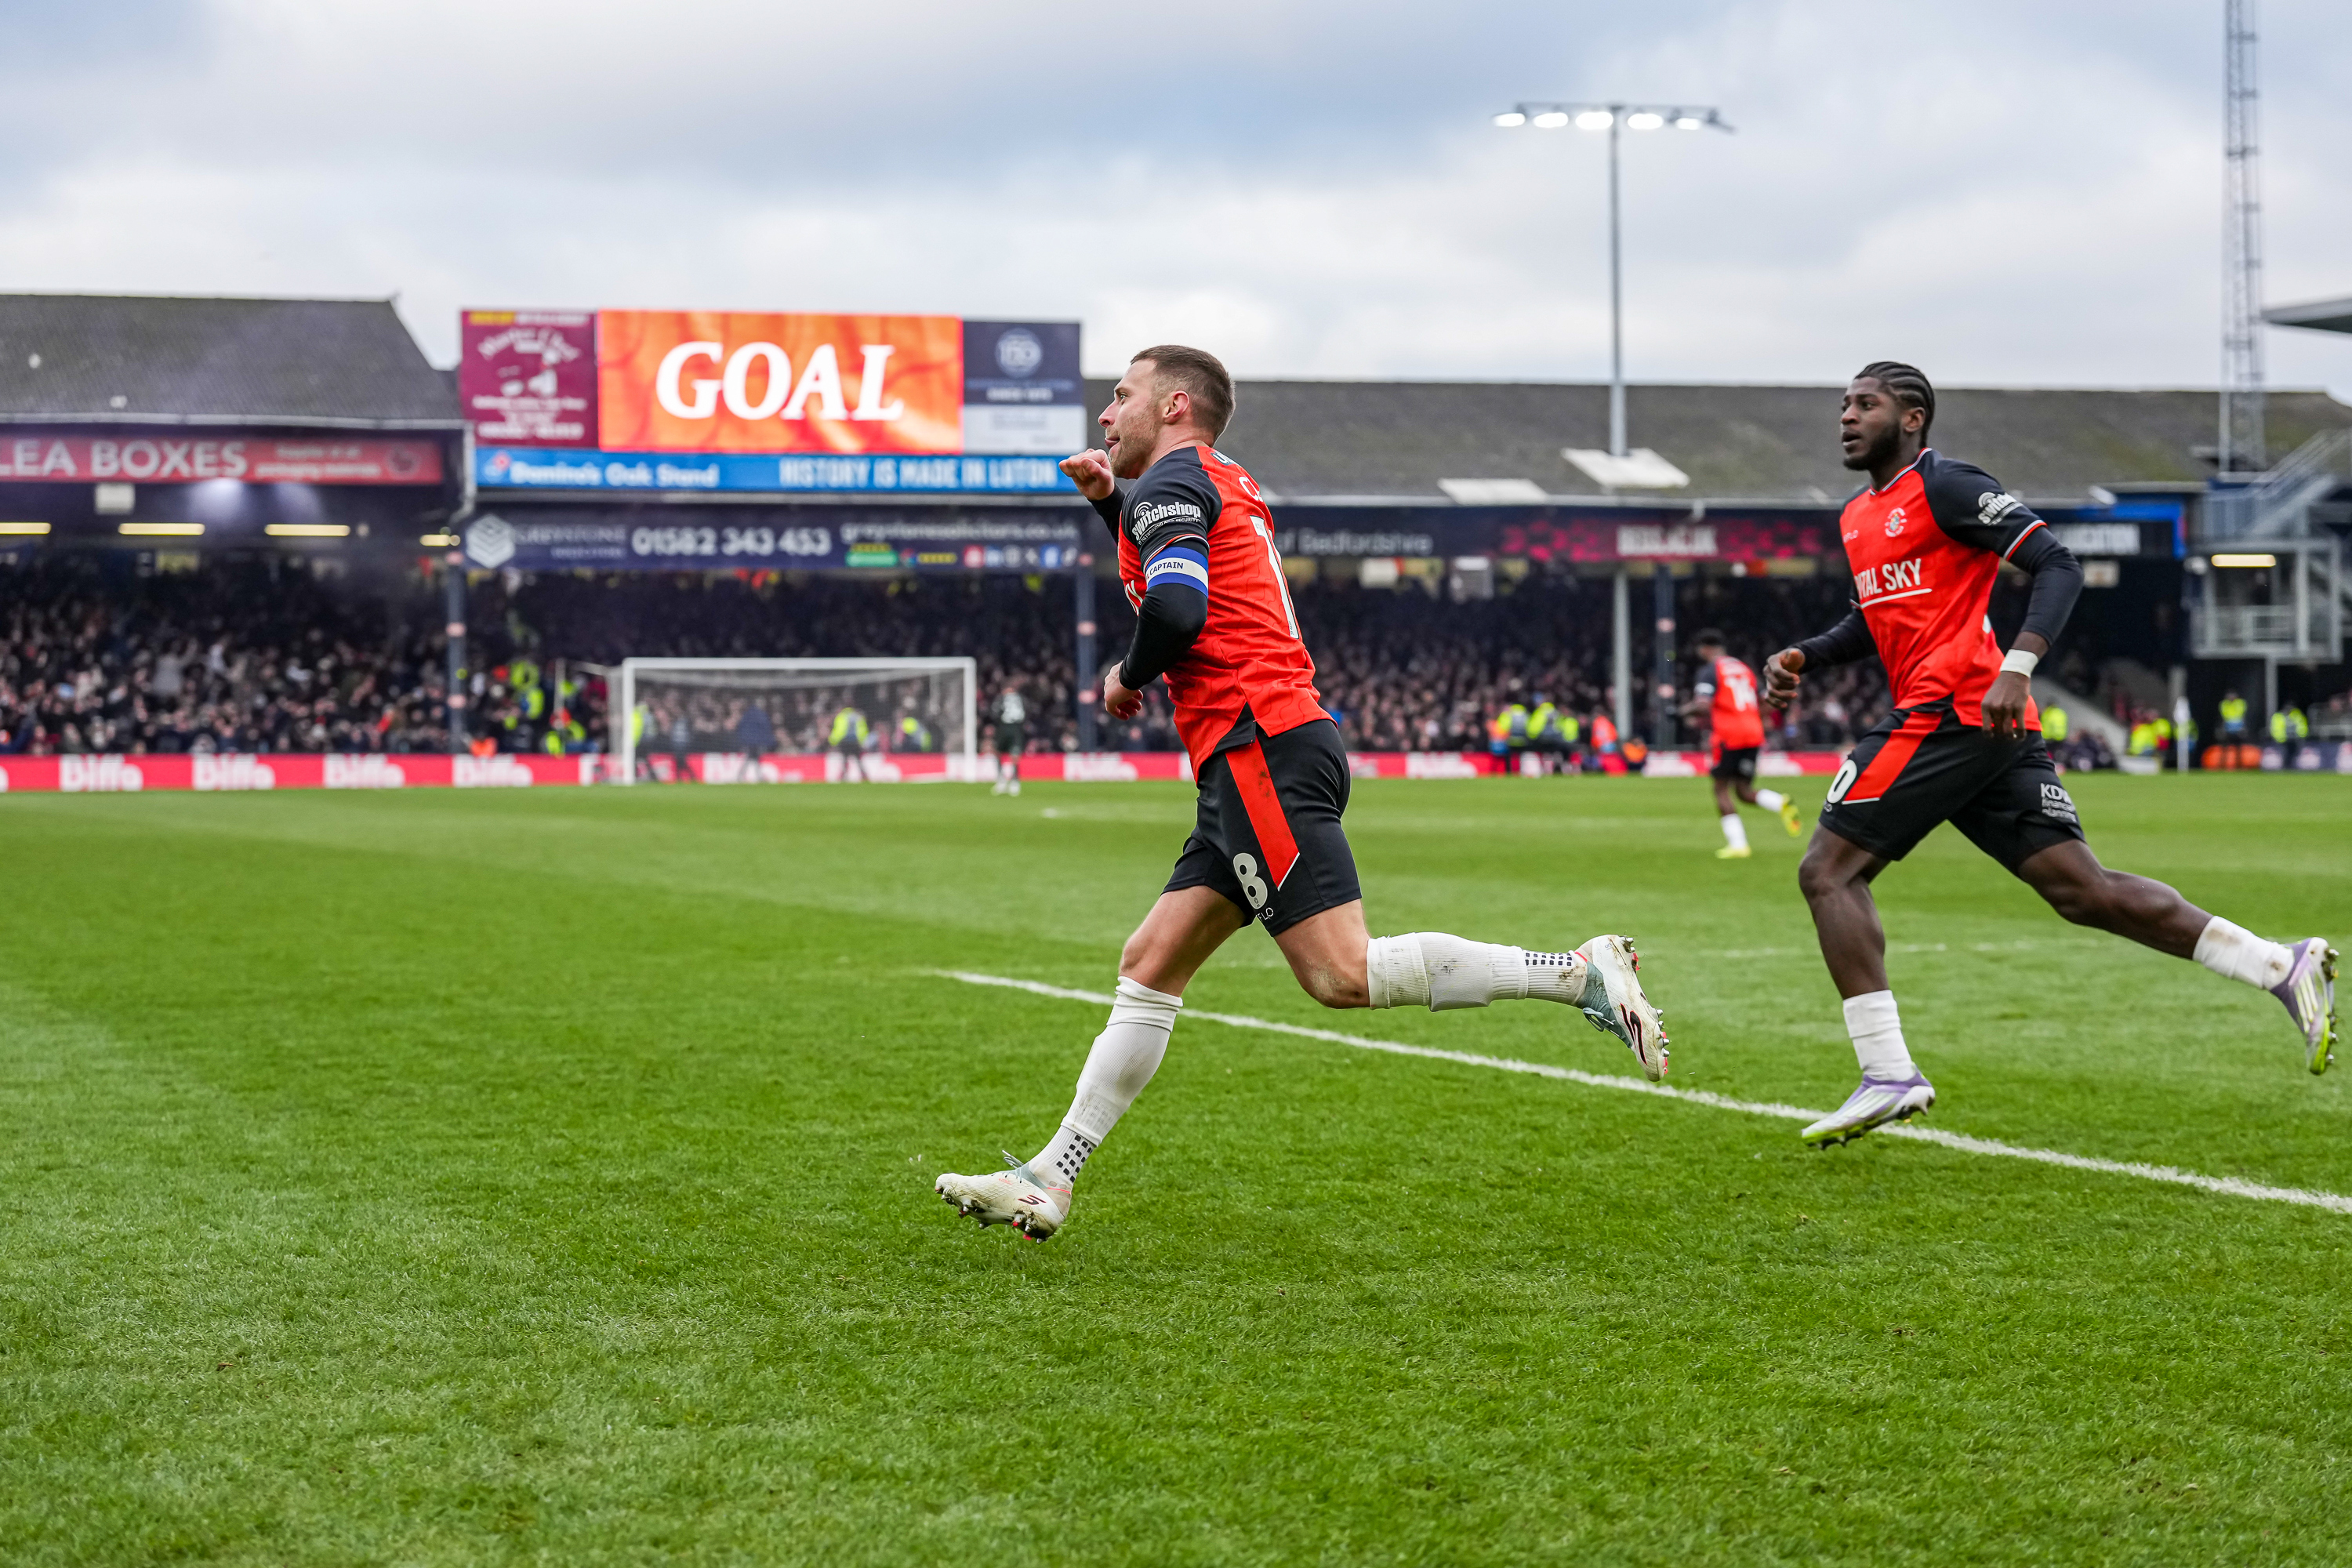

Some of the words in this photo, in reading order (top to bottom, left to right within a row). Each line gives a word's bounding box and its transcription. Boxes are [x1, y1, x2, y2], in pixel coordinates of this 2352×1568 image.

[656, 340, 905, 421] GOAL
[0, 441, 78, 477] EA
[91, 441, 248, 477] BOXES
[780, 458, 869, 487] HISTORY
[874, 459, 896, 487] IS
[900, 459, 958, 488] MADE
[962, 459, 986, 487] IN
[989, 459, 1057, 488] LUTON
[633, 526, 716, 556] 01582
[1149, 561, 1184, 575] CAPTAIN
[1882, 557, 1922, 591] SKY
